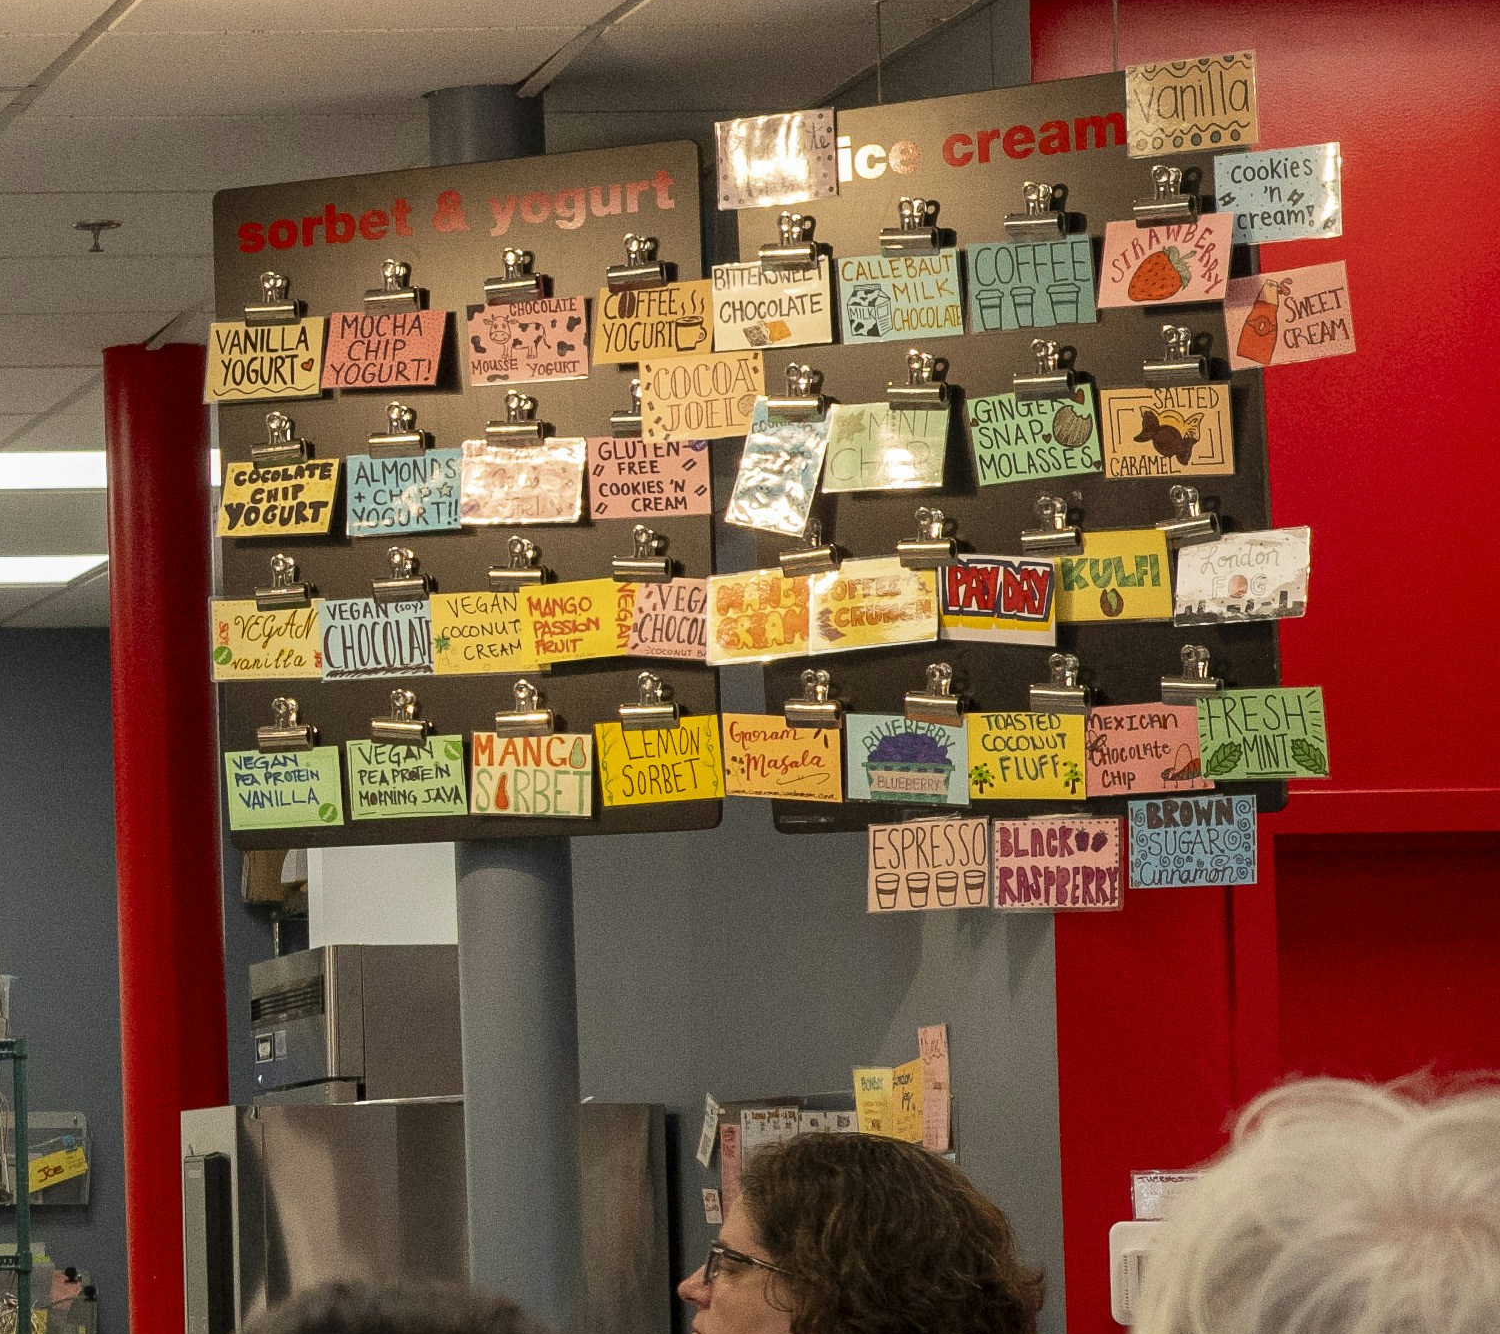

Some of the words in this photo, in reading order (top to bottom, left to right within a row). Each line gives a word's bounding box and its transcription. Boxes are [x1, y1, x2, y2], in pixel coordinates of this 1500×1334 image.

[1133, 73, 1249, 126] vanilla
[838, 136, 922, 183] ice
[942, 109, 1125, 166] cream
[1231, 157, 1313, 185] cookies
[238, 198, 412, 254] sorbet
[432, 189, 471, 233] &
[488, 170, 676, 238] yogurt
[1236, 204, 1315, 229] cream!
[974, 242, 1090, 285] COFFEE
[1110, 222, 1223, 296] STRAWBERRY
[603, 288, 678, 319] COFFEE
[719, 293, 824, 322] CHOCOLATE
[1284, 286, 1347, 321] SWEET
[216, 326, 310, 355] VANILLA
[341, 313, 424, 339] MOCHA
[601, 319, 675, 352] YOGURT
[1283, 318, 1348, 349] CREAM
[347, 339, 407, 362] CHIP
[220, 355, 298, 387] YOGURT
[330, 359, 433, 387] YOGURT!
[1152, 385, 1219, 409] SALTED
[978, 423, 1043, 449] SNAP
[978, 445, 1094, 481] MOLASSES
[1109, 454, 1181, 476] CARAMEL
[1062, 554, 1160, 591] KULFI
[527, 595, 592, 616] MANGO
[947, 565, 1000, 612] PAY
[1002, 565, 1052, 615] DAY
[535, 616, 600, 637] PASSION
[535, 638, 583, 656] FRUIT
[982, 713, 1062, 733] TOASTED
[1205, 694, 1308, 738] FRESH
[622, 726, 700, 760] LEMON
[981, 732, 1067, 751] COCONUT
[1242, 736, 1289, 771] MINT
[622, 759, 700, 798] SORBET
[999, 754, 1061, 781] FLUFF
[1146, 798, 1233, 829] BROWN
[872, 823, 987, 870] ESPRESSO
[999, 827, 1073, 858] BLACK
[1146, 828, 1224, 856] SUGAR
[998, 868, 1120, 906] RASPBERRY
[1136, 859, 1239, 886] Cinnamon
